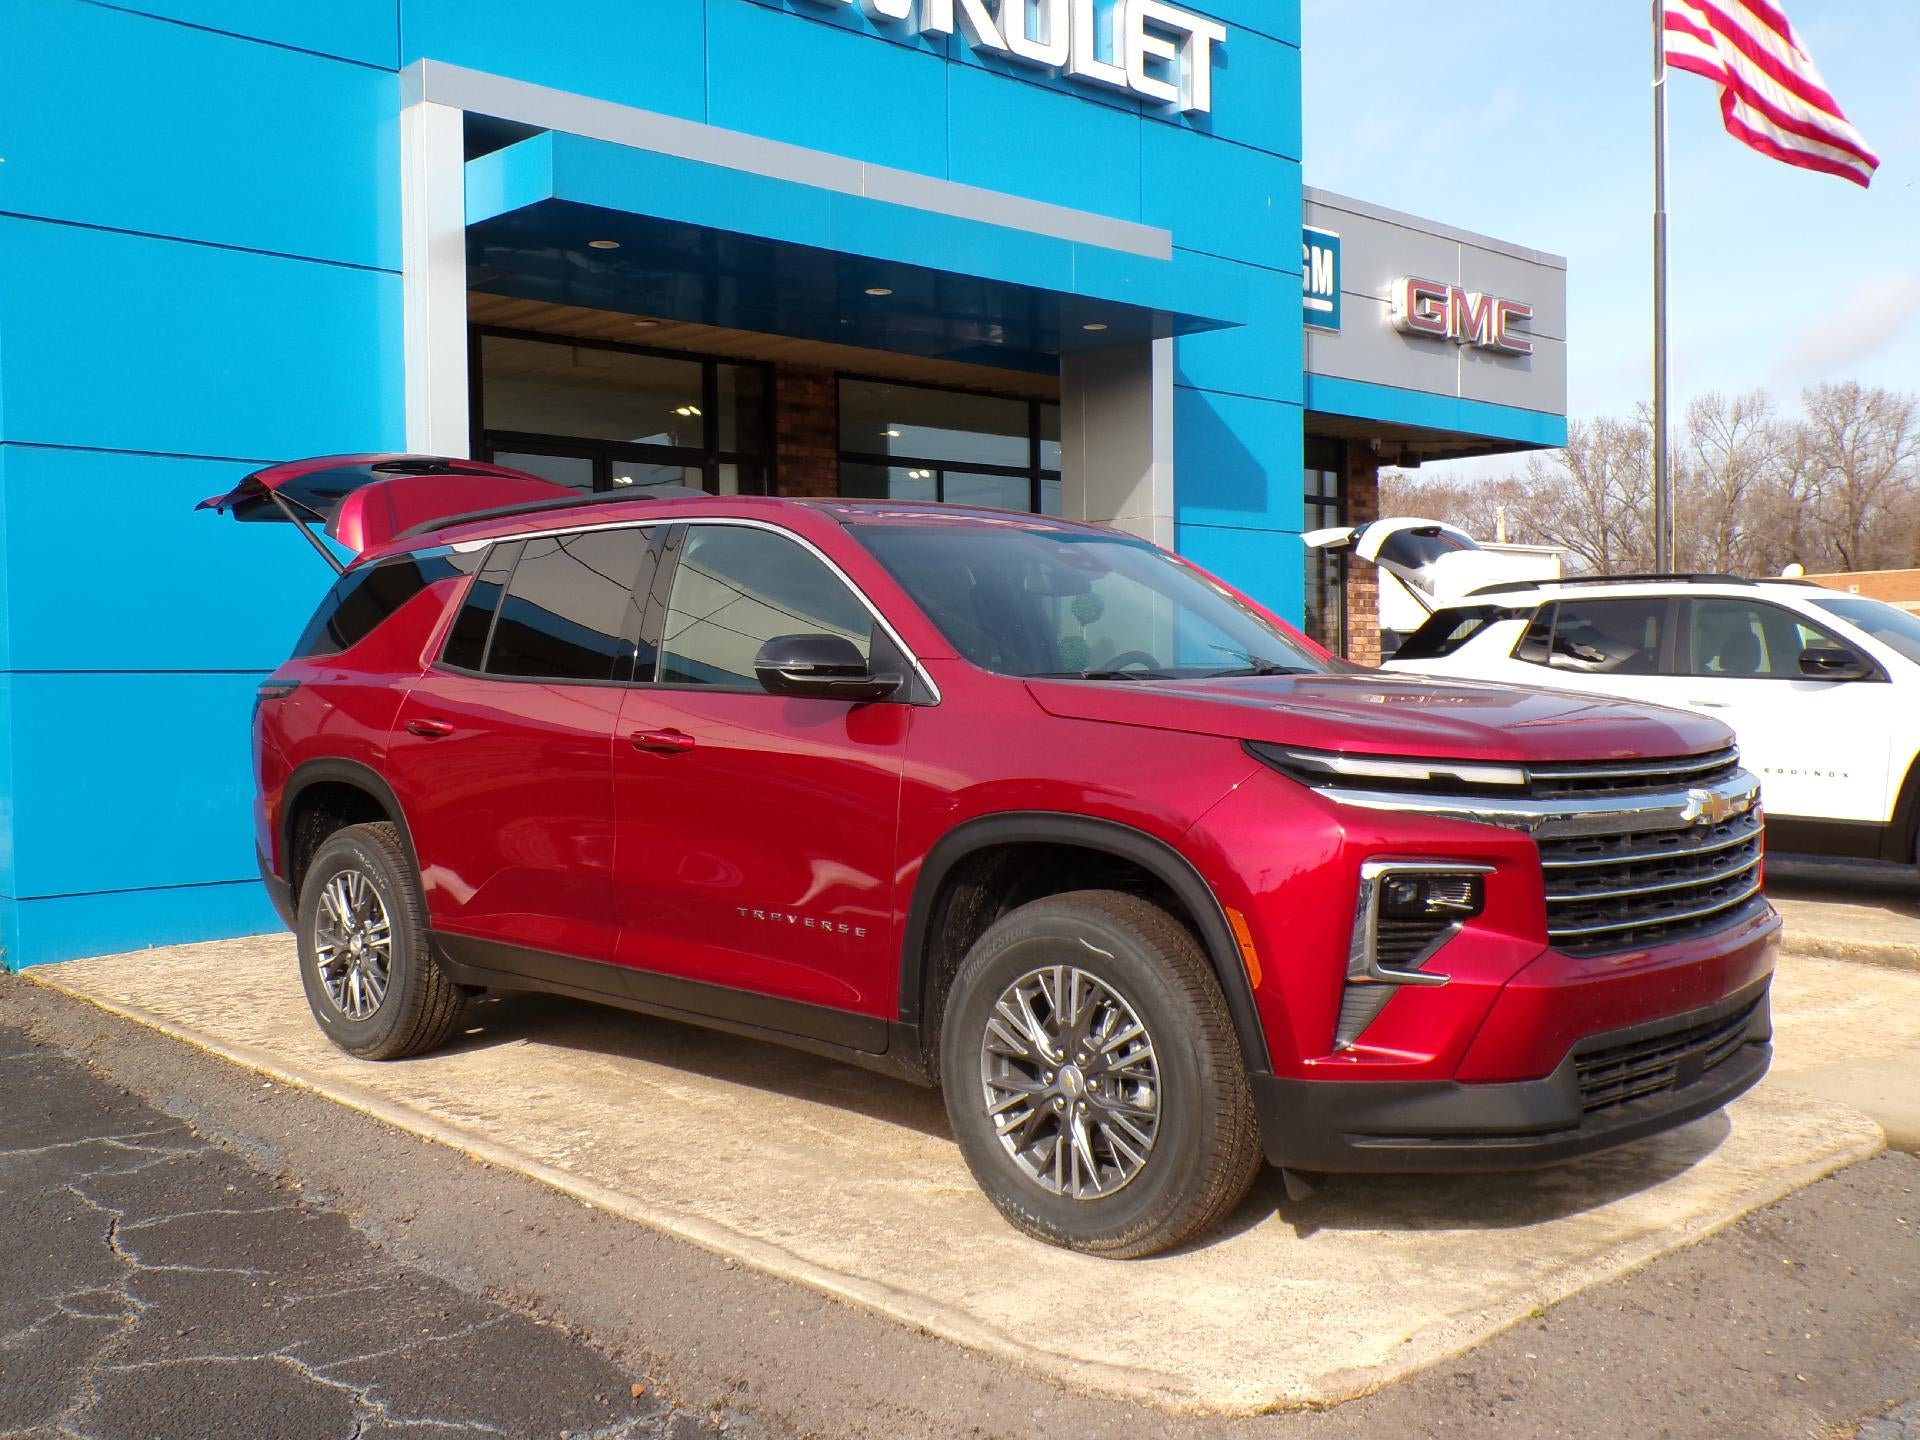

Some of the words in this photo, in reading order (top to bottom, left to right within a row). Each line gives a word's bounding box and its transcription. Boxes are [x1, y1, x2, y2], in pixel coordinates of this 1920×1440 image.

[1400, 275, 1534, 357] GMC
[1763, 767, 1849, 778] EQUINOX
[736, 907, 867, 937] TRAVERSE
